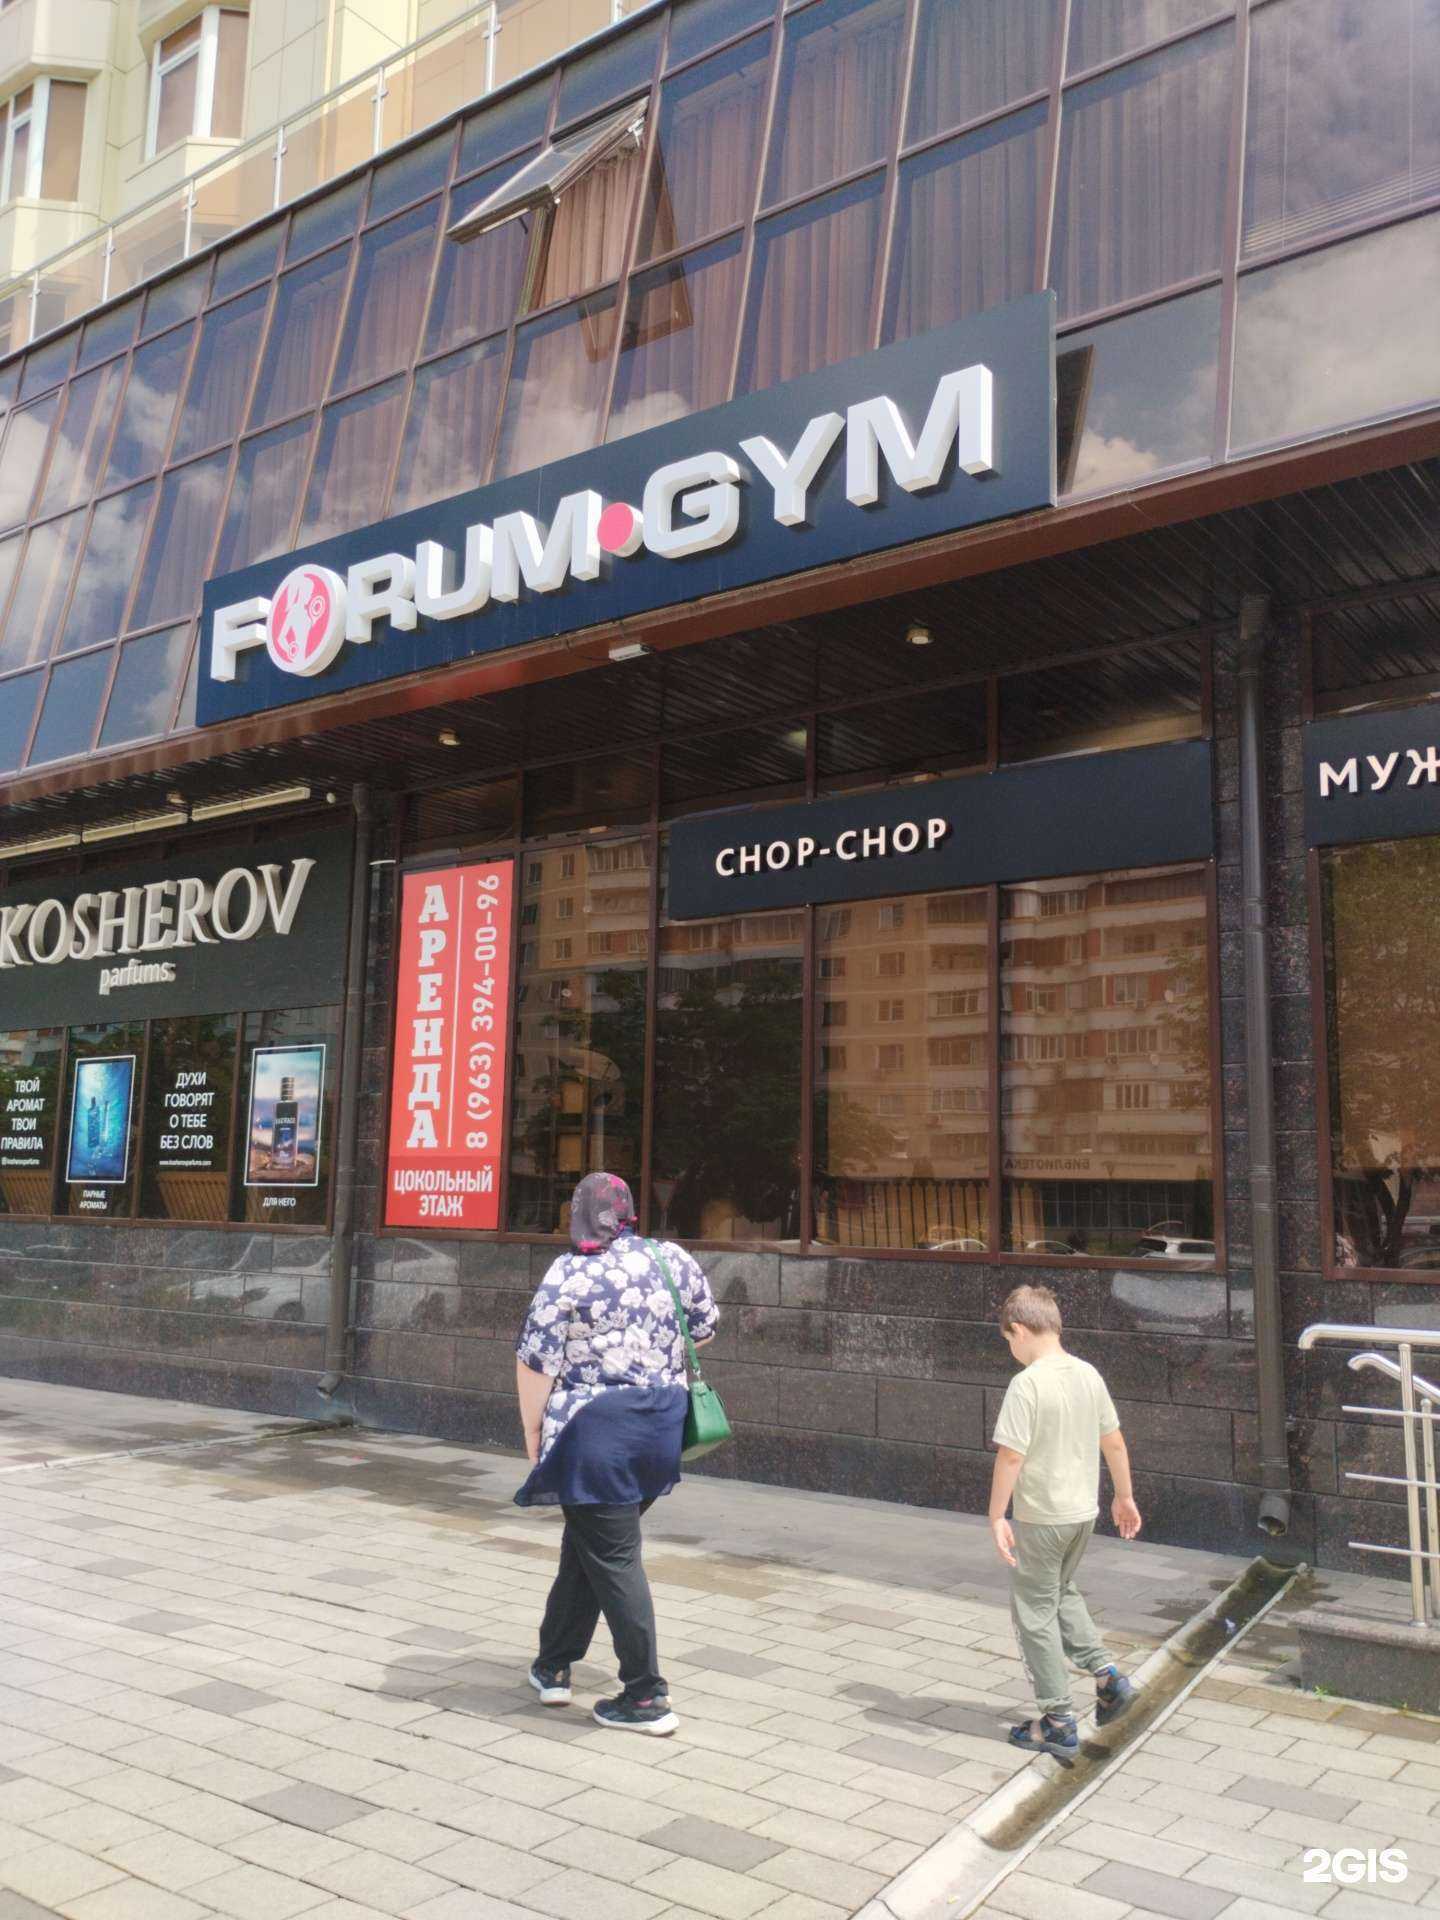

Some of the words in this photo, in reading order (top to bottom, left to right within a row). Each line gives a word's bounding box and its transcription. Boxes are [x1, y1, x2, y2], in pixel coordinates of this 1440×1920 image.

[642, 363, 993, 559] GYM
[1320, 746, 1440, 796] МУЖ
[715, 818, 947, 876] CHOP-CHOP
[0, 858, 317, 968] KOSHEROV
[471, 875, 499, 1031] 394-00-96
[99, 958, 176, 995] parfums
[407, 885, 449, 1148] АРЕНДА
[15, 1077, 40, 1093] ТВОЙ
[176, 1072, 206, 1089] ДУХИ
[466, 1042, 495, 1120] (963)
[6, 1098, 45, 1112] АРОМАТ
[164, 1093, 215, 1107] ГОВОРЯТ
[12, 1118, 36, 1131] ТВОИ
[170, 1116, 179, 1128] О
[181, 1114, 207, 1128] ТЕБЕ
[1, 1137, 43, 1150] ПРАВИЛА
[160, 1135, 179, 1149] БЕЗ
[182, 1135, 213, 1149] СЛОВ
[465, 1132, 488, 1148] 8
[394, 1165, 492, 1194] ЦОКОЛЬНЫЙ
[79, 1201, 107, 1209] АРОМАТЫ
[419, 1195, 464, 1217] ЭТАЖ
